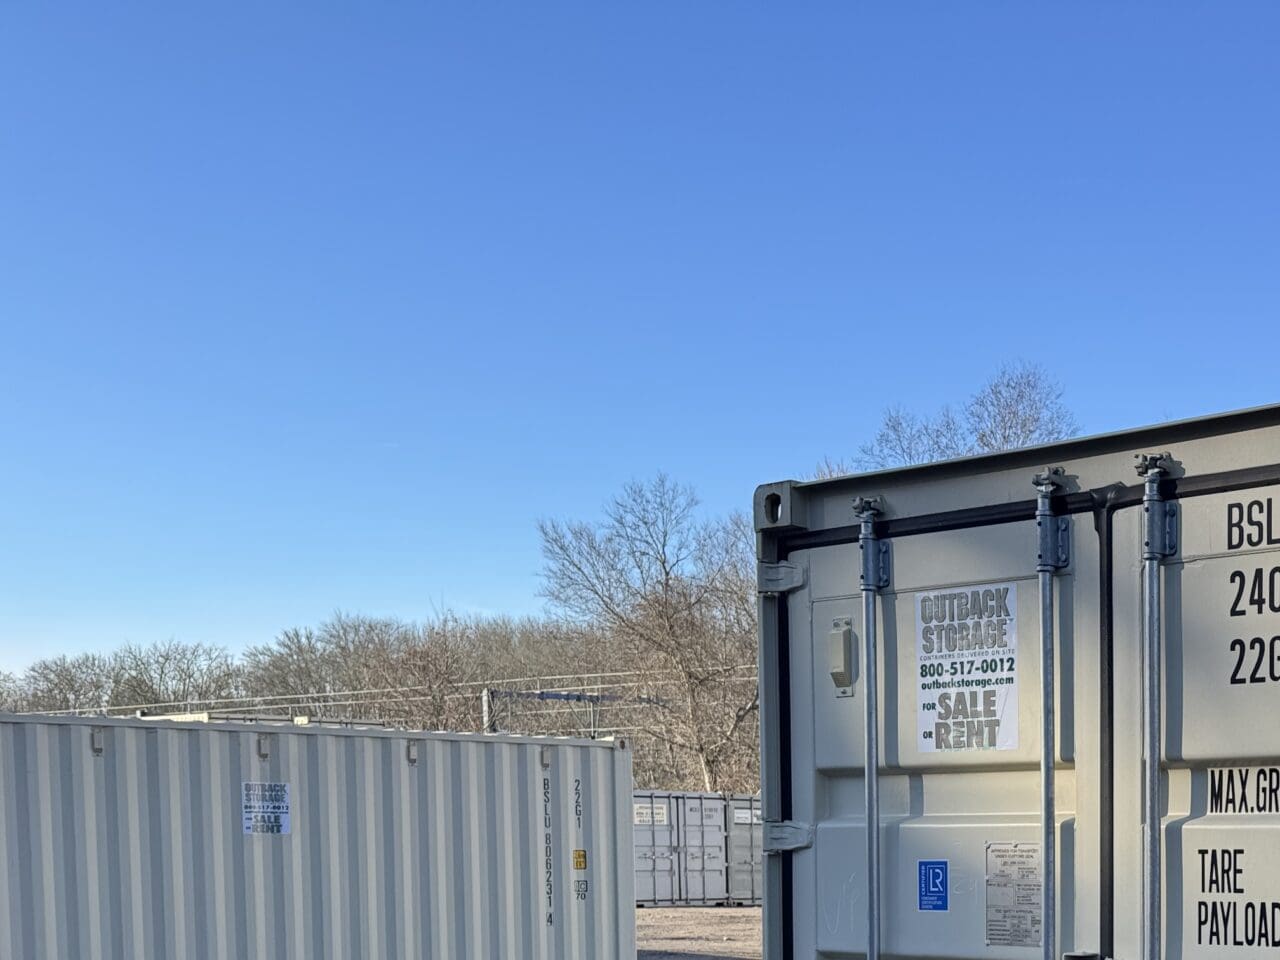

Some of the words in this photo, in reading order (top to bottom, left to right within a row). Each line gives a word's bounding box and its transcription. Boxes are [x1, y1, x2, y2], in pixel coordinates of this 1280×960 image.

[920, 587, 1011, 625] OUTBACK
[921, 618, 1008, 654] STORAGE
[920, 657, 1015, 678] 800-517-0012
[921, 676, 1014, 690] outbackstorage.com
[922, 702, 937, 711] FOR
[937, 689, 997, 721] SALE
[922, 731, 933, 739] OR
[935, 718, 1000, 750] RENT
[252, 824, 283, 834] RENT
[253, 815, 281, 824] SALE
[1198, 849, 1245, 894] TARE
